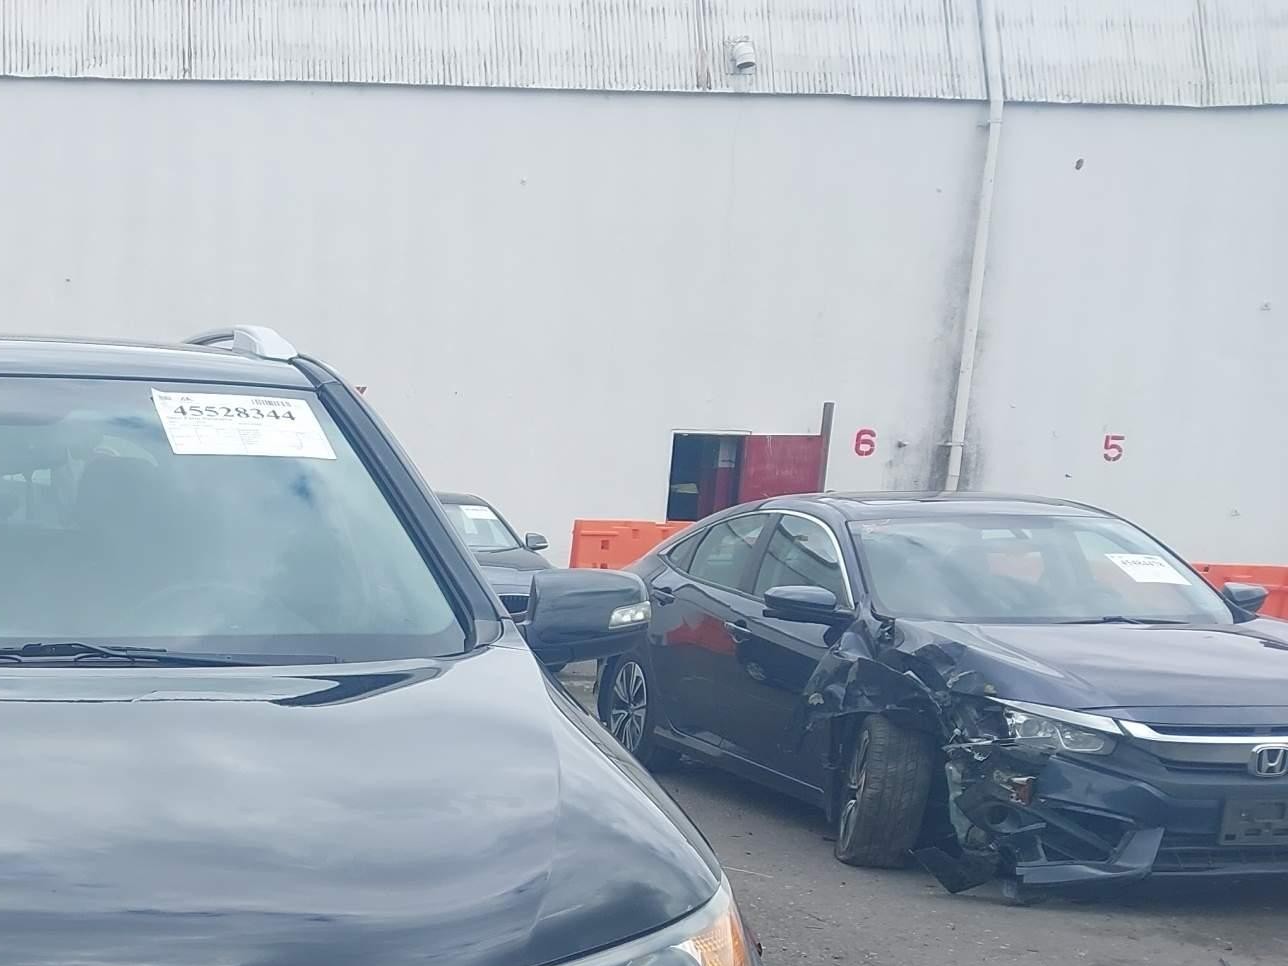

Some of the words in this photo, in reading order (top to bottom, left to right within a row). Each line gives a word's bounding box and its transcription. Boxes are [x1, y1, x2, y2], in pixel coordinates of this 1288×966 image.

[173, 404, 296, 421] 45528344
[854, 428, 877, 457] 6
[1103, 434, 1126, 462] 5
